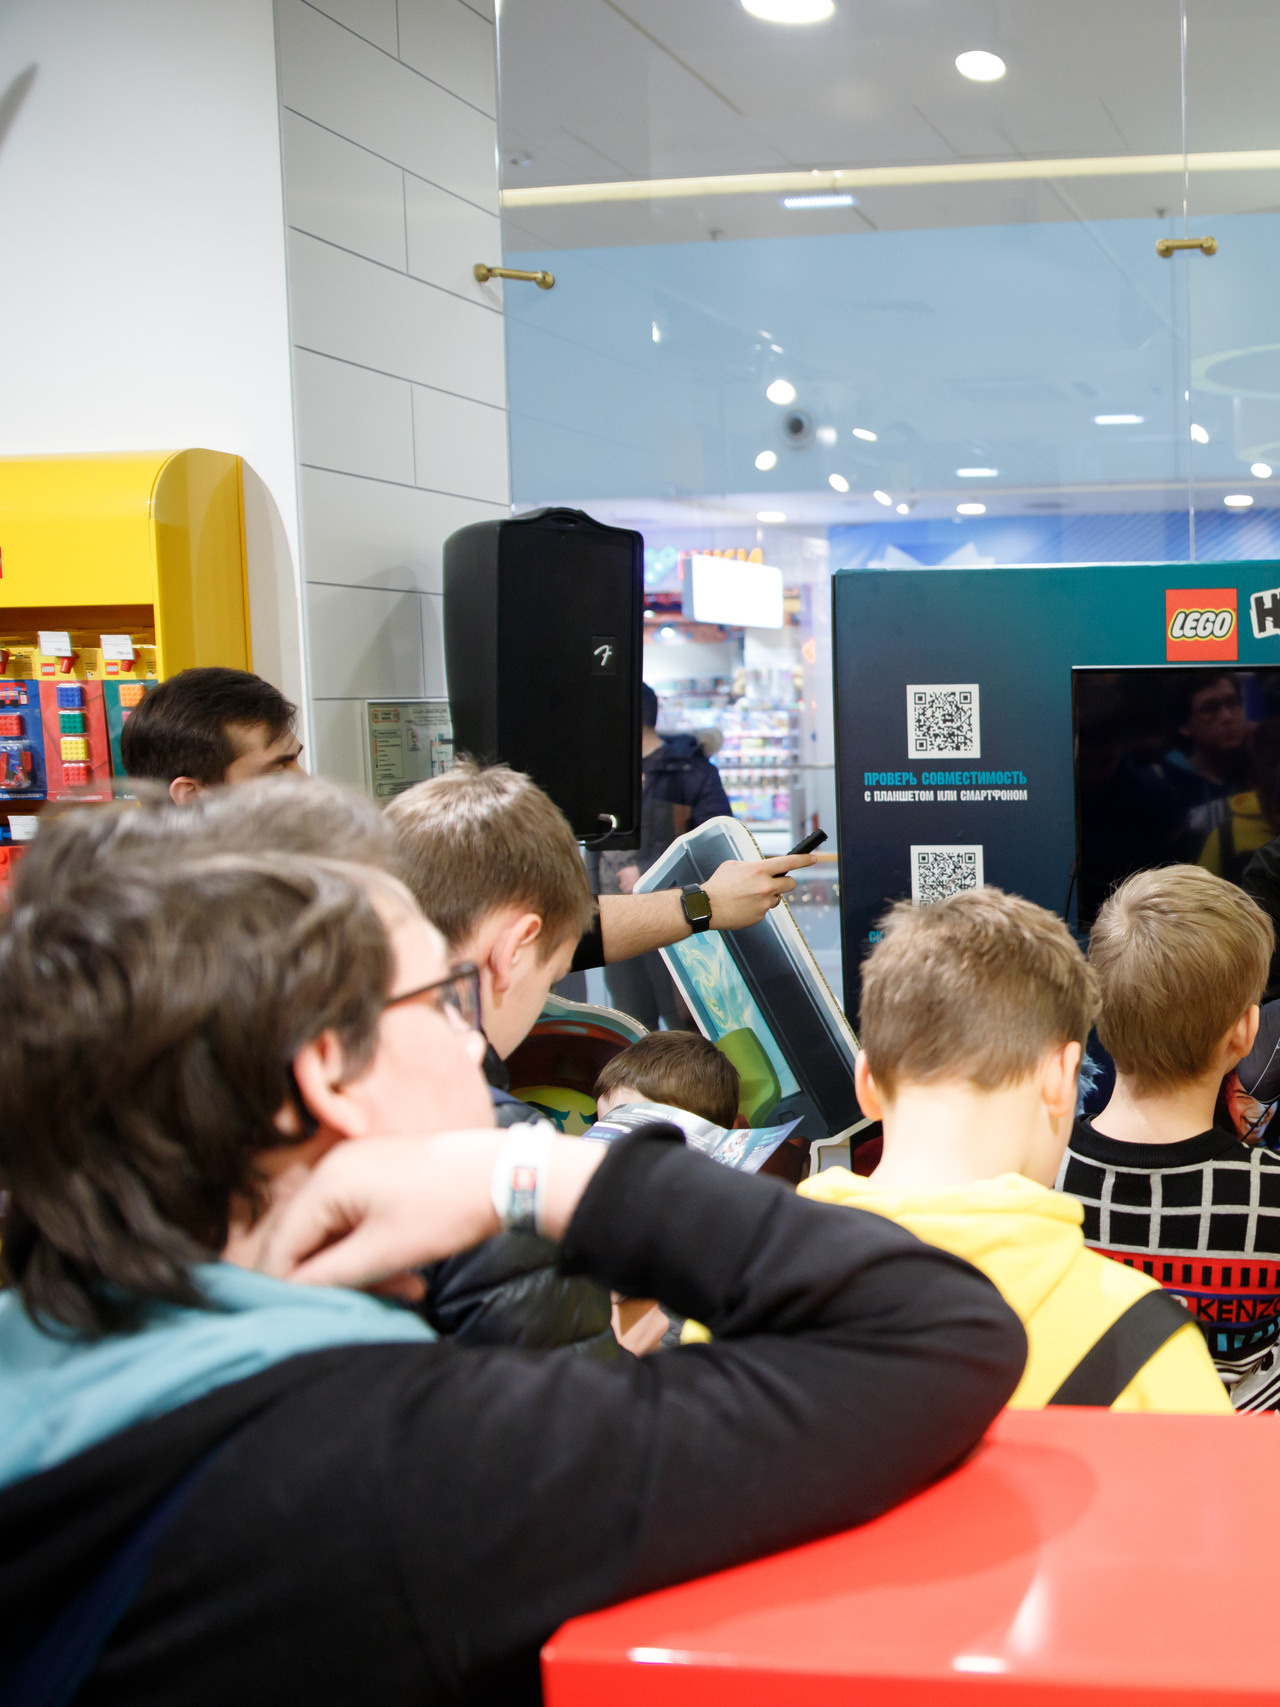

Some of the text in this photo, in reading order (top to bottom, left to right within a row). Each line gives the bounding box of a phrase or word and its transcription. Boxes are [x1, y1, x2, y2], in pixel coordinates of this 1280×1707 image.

[1170, 609, 1234, 640] LEGO
[864, 771, 1027, 786] ПРОВЕРЬ СОВМЕСТИМОСТЬ
[864, 789, 1028, 802] С ПЛАНШЕТОМ ИЛИ СМАРТФОНОМ
